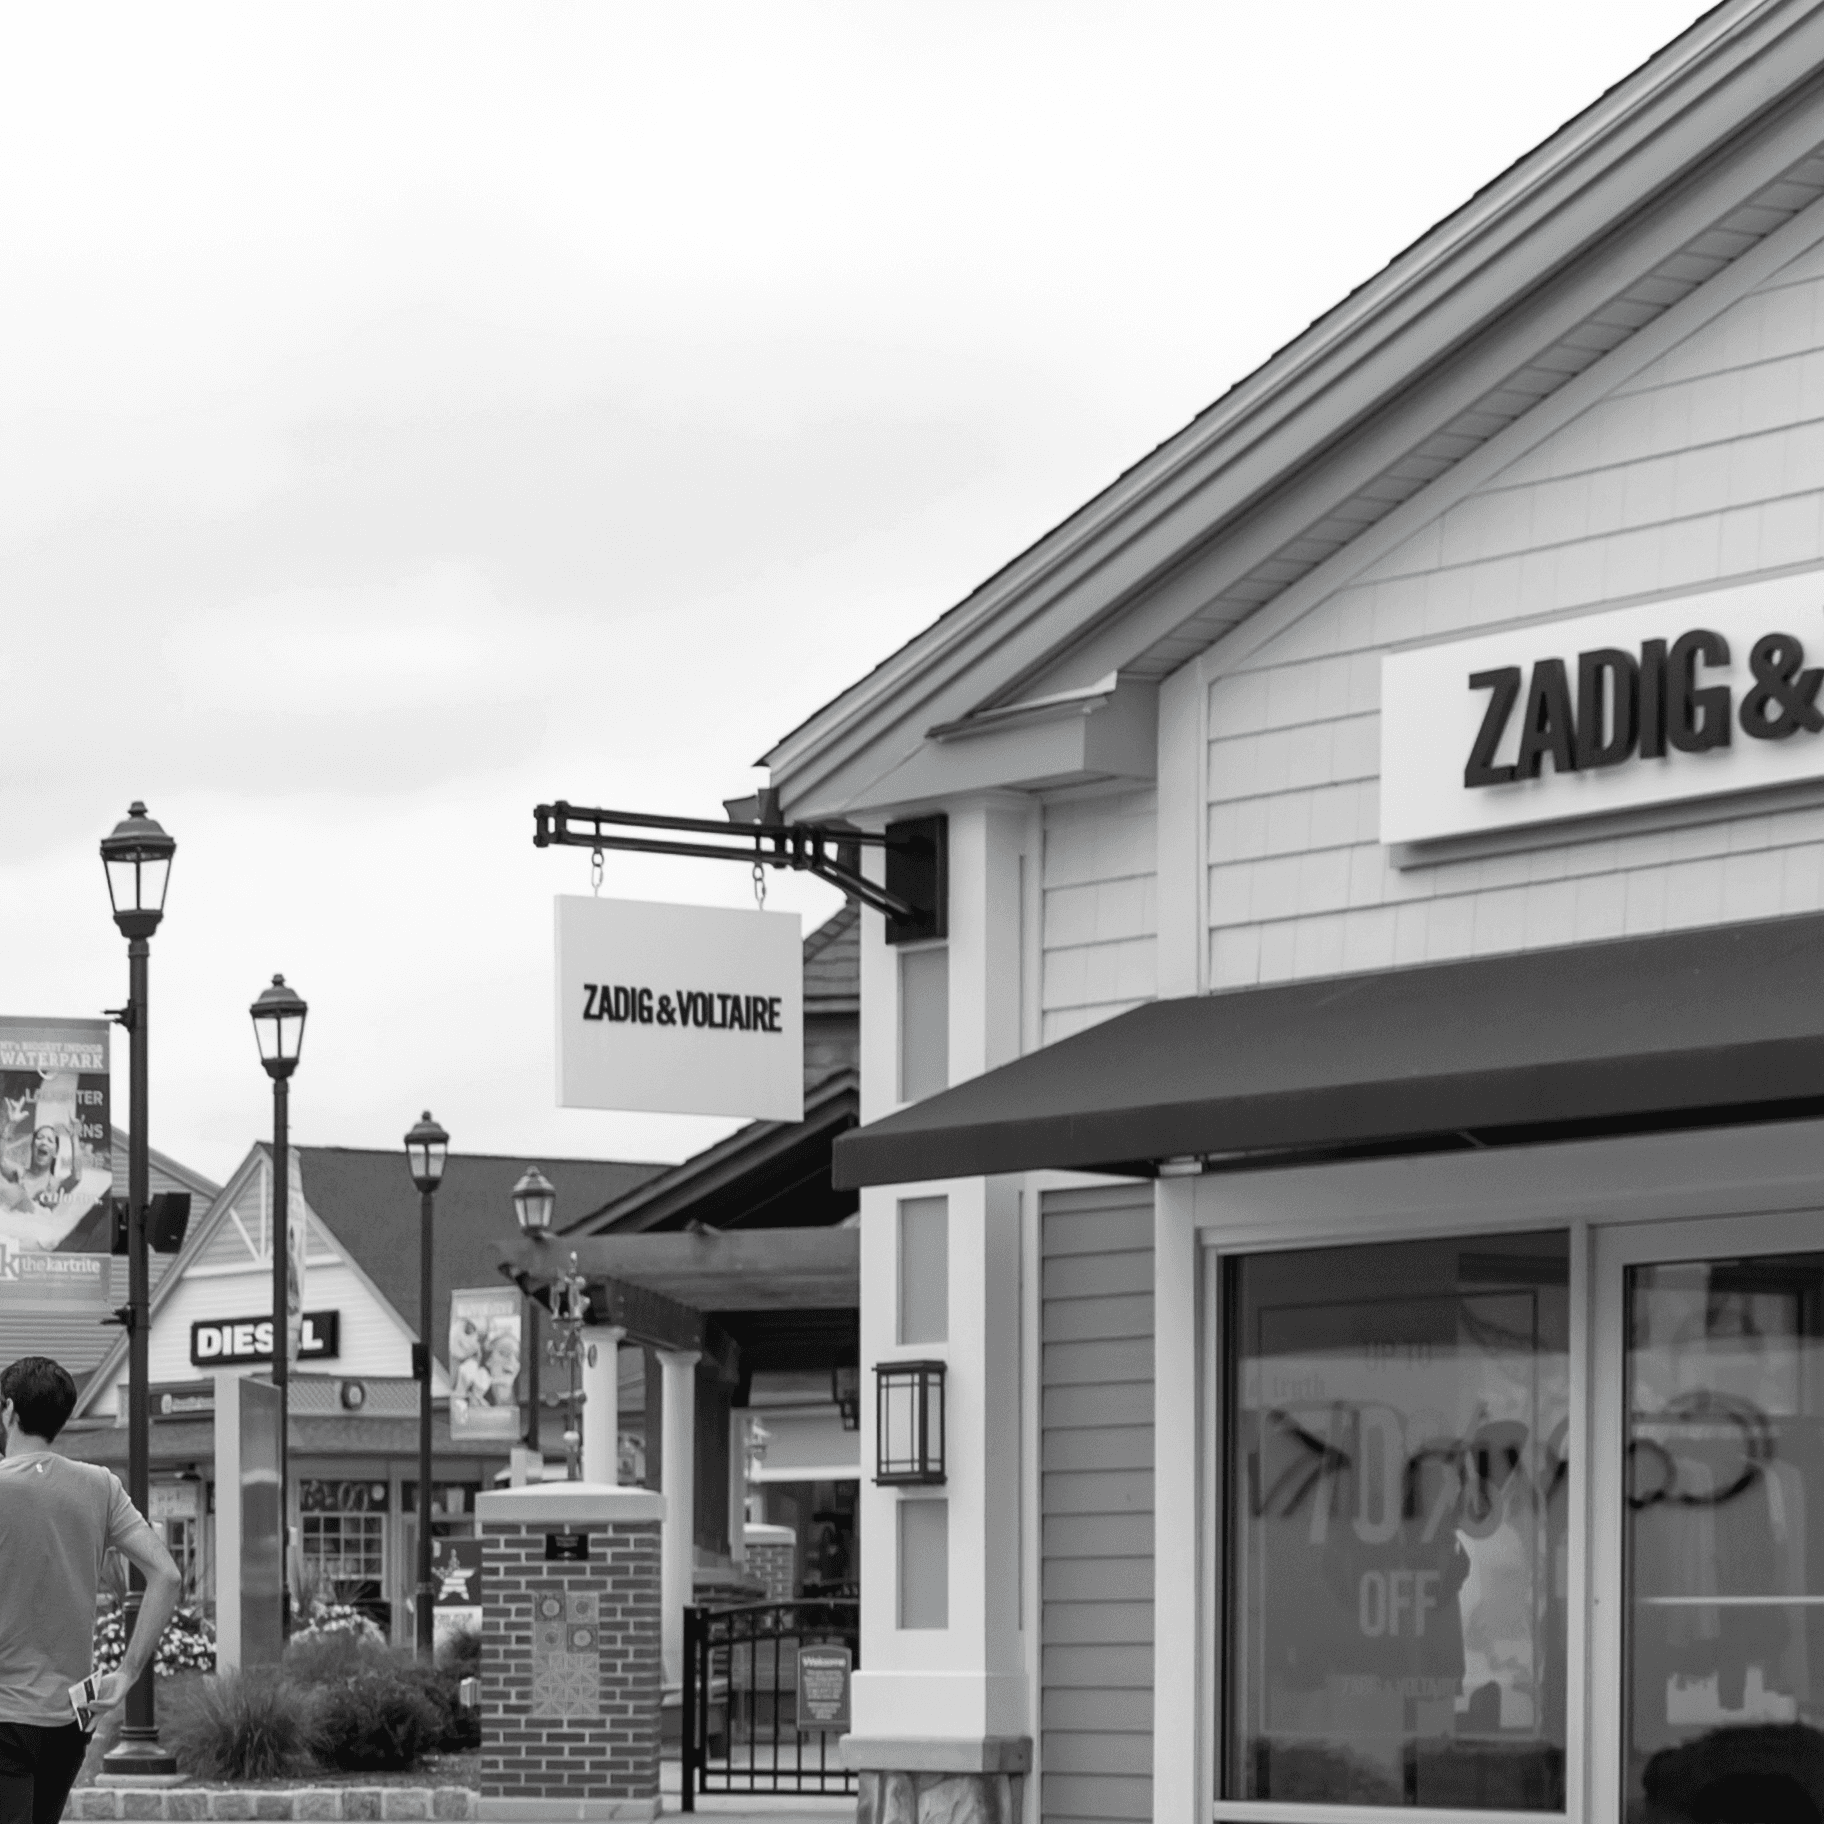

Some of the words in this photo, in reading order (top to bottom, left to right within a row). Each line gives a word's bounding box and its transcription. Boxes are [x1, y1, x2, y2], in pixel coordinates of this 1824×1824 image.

[0, 1051, 104, 1069] WATERPARK
[197, 1319, 324, 1358] DIESL
[1359, 1570, 1441, 1638] OFF
